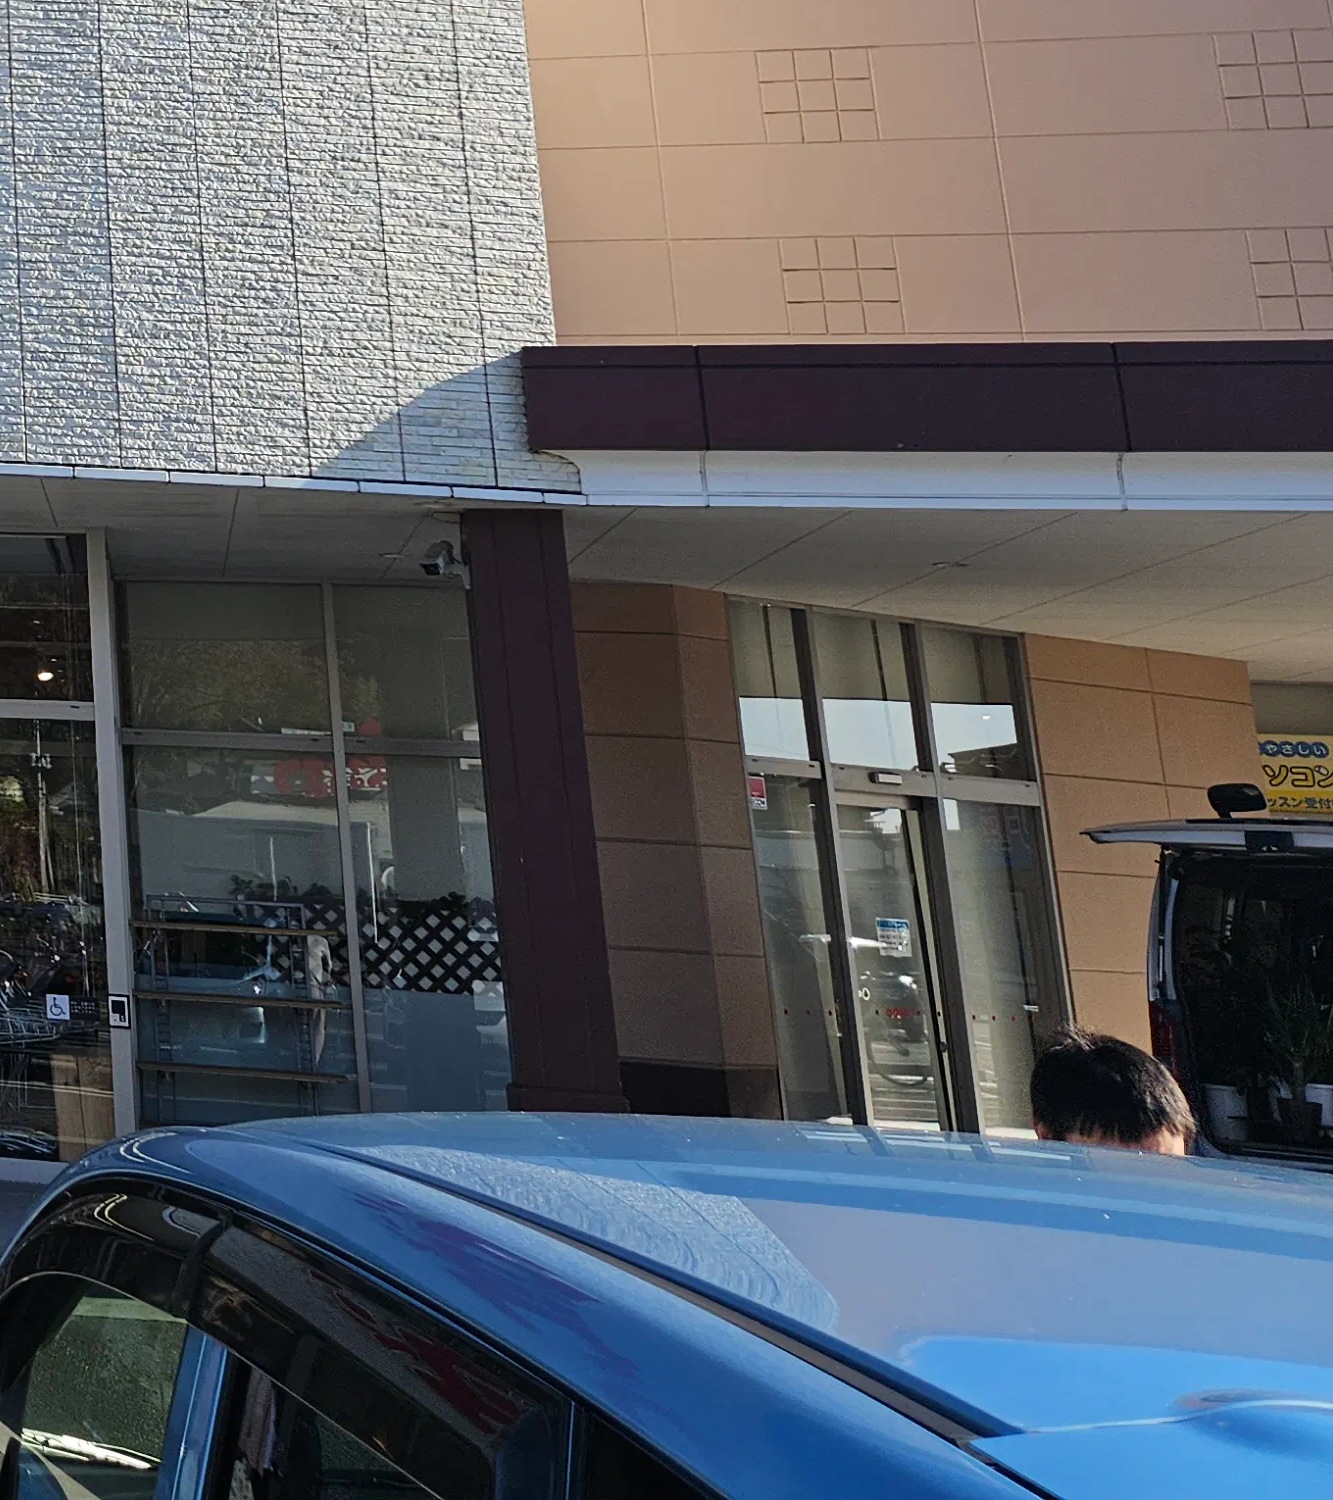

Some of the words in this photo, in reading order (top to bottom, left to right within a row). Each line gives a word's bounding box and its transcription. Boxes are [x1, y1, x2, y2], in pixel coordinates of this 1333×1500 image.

[1264, 743, 1327, 755] やさしい
[1262, 764, 1333, 788] ソコン
